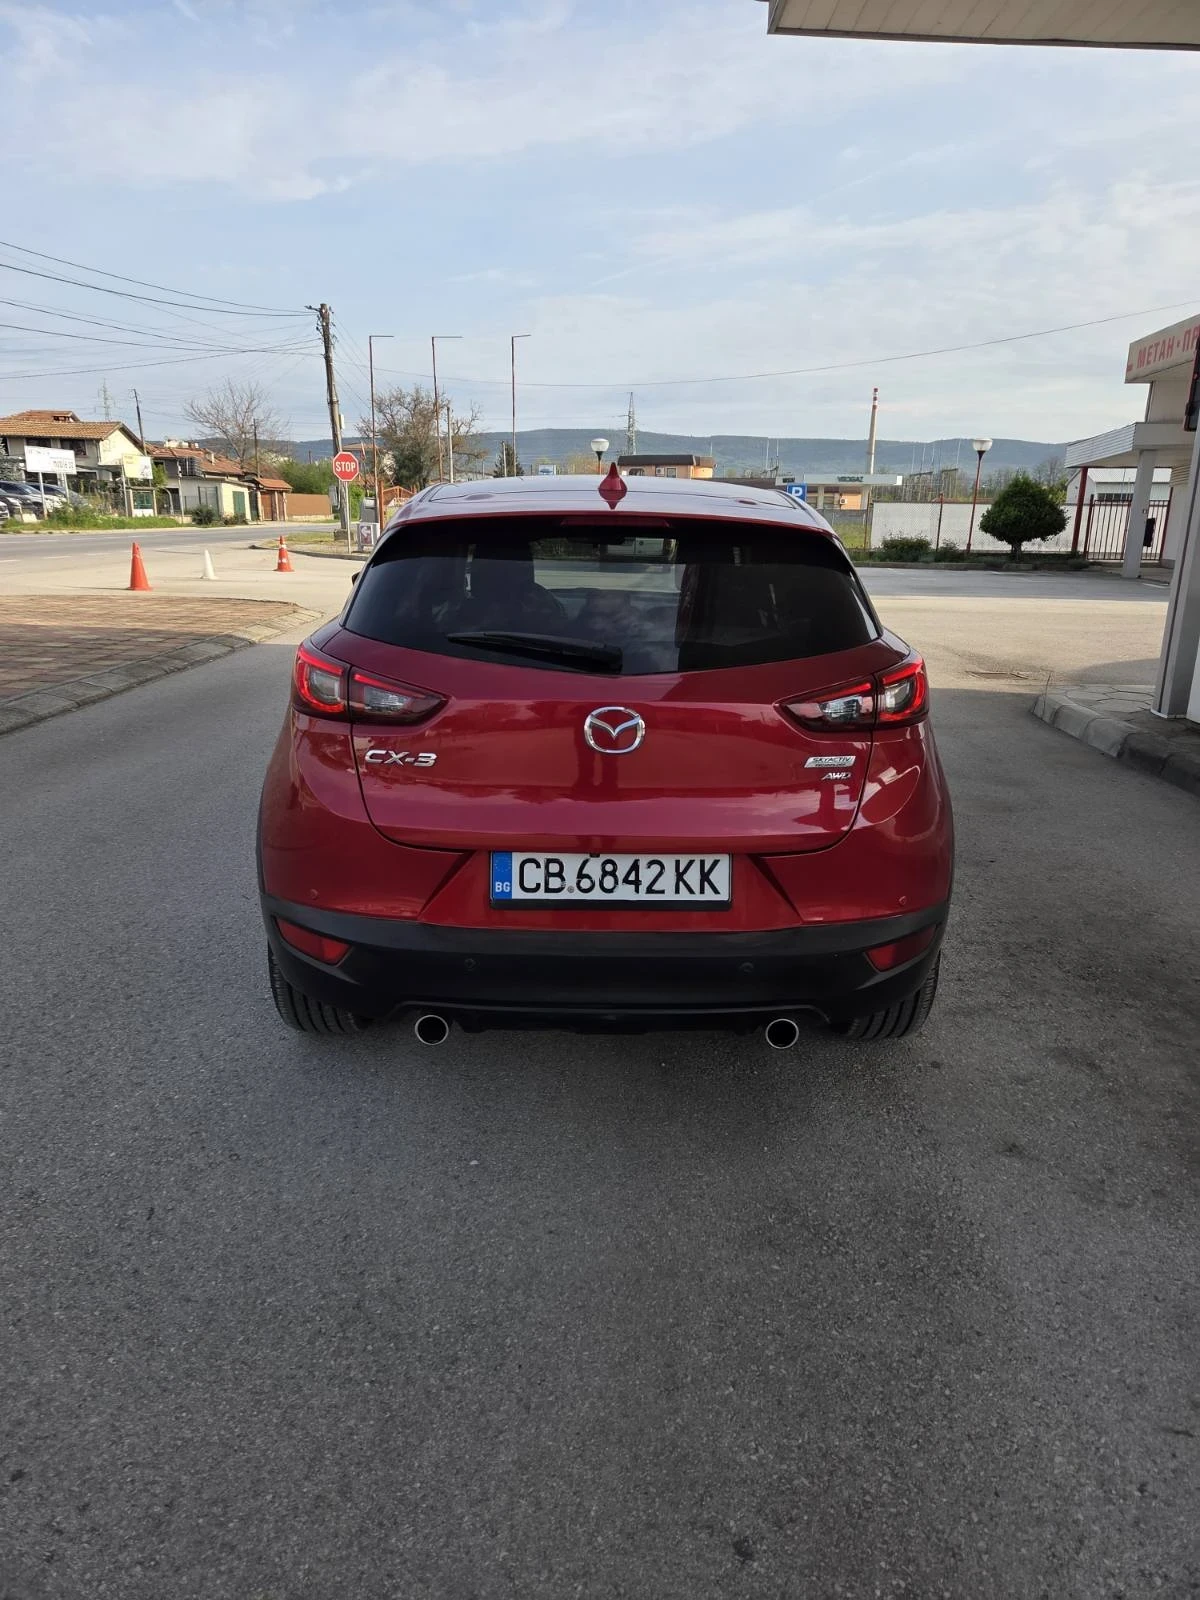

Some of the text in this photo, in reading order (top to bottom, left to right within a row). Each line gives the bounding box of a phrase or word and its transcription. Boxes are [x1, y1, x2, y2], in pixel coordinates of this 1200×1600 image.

[1137, 336, 1175, 368] МЕТАН
[335, 461, 356, 472] STOP
[791, 487, 803, 497] P
[364, 749, 438, 767] CX-3
[821, 772, 852, 780] AWD
[576, 858, 666, 895] 6842
[495, 881, 511, 893] BG
